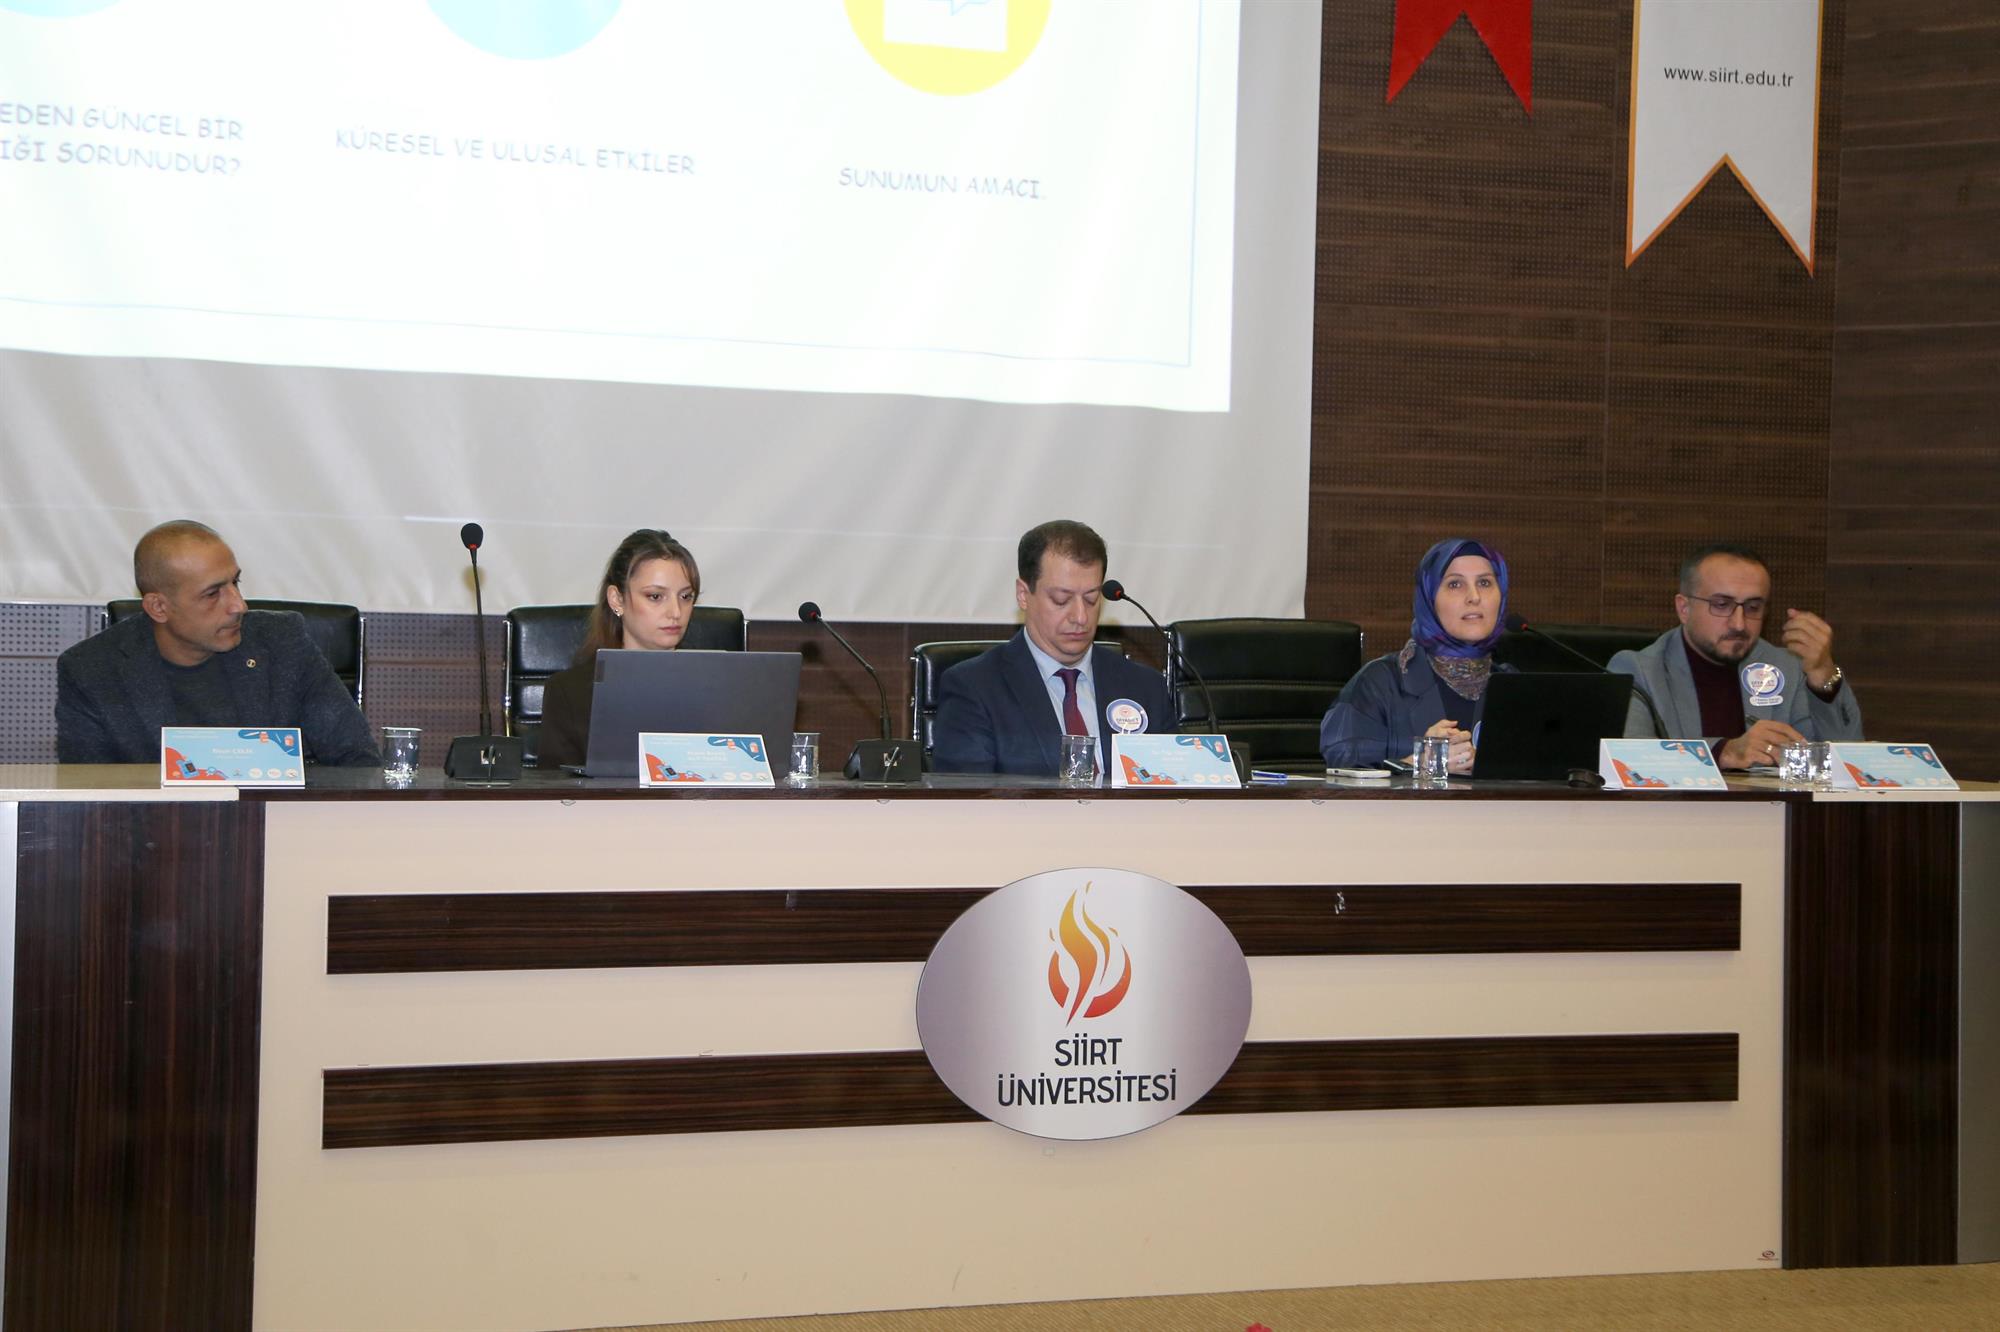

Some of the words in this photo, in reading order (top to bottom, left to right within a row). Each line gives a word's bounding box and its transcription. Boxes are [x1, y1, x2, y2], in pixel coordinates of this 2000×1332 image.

[1664, 67, 1794, 87] www.siirt.edu.tr
[0, 103, 74, 126] EDEN
[83, 105, 187, 137] GÜNCEL
[56, 142, 242, 175] SORUNUDUR?
[336, 124, 446, 157] KÜRESEL
[454, 138, 484, 159] VE
[493, 141, 587, 167] ULUSAL
[838, 167, 957, 193] SUNUMUN
[1054, 1032, 1123, 1067] SİİRT
[998, 1068, 1177, 1106] ÜNİVERSİTESİ
